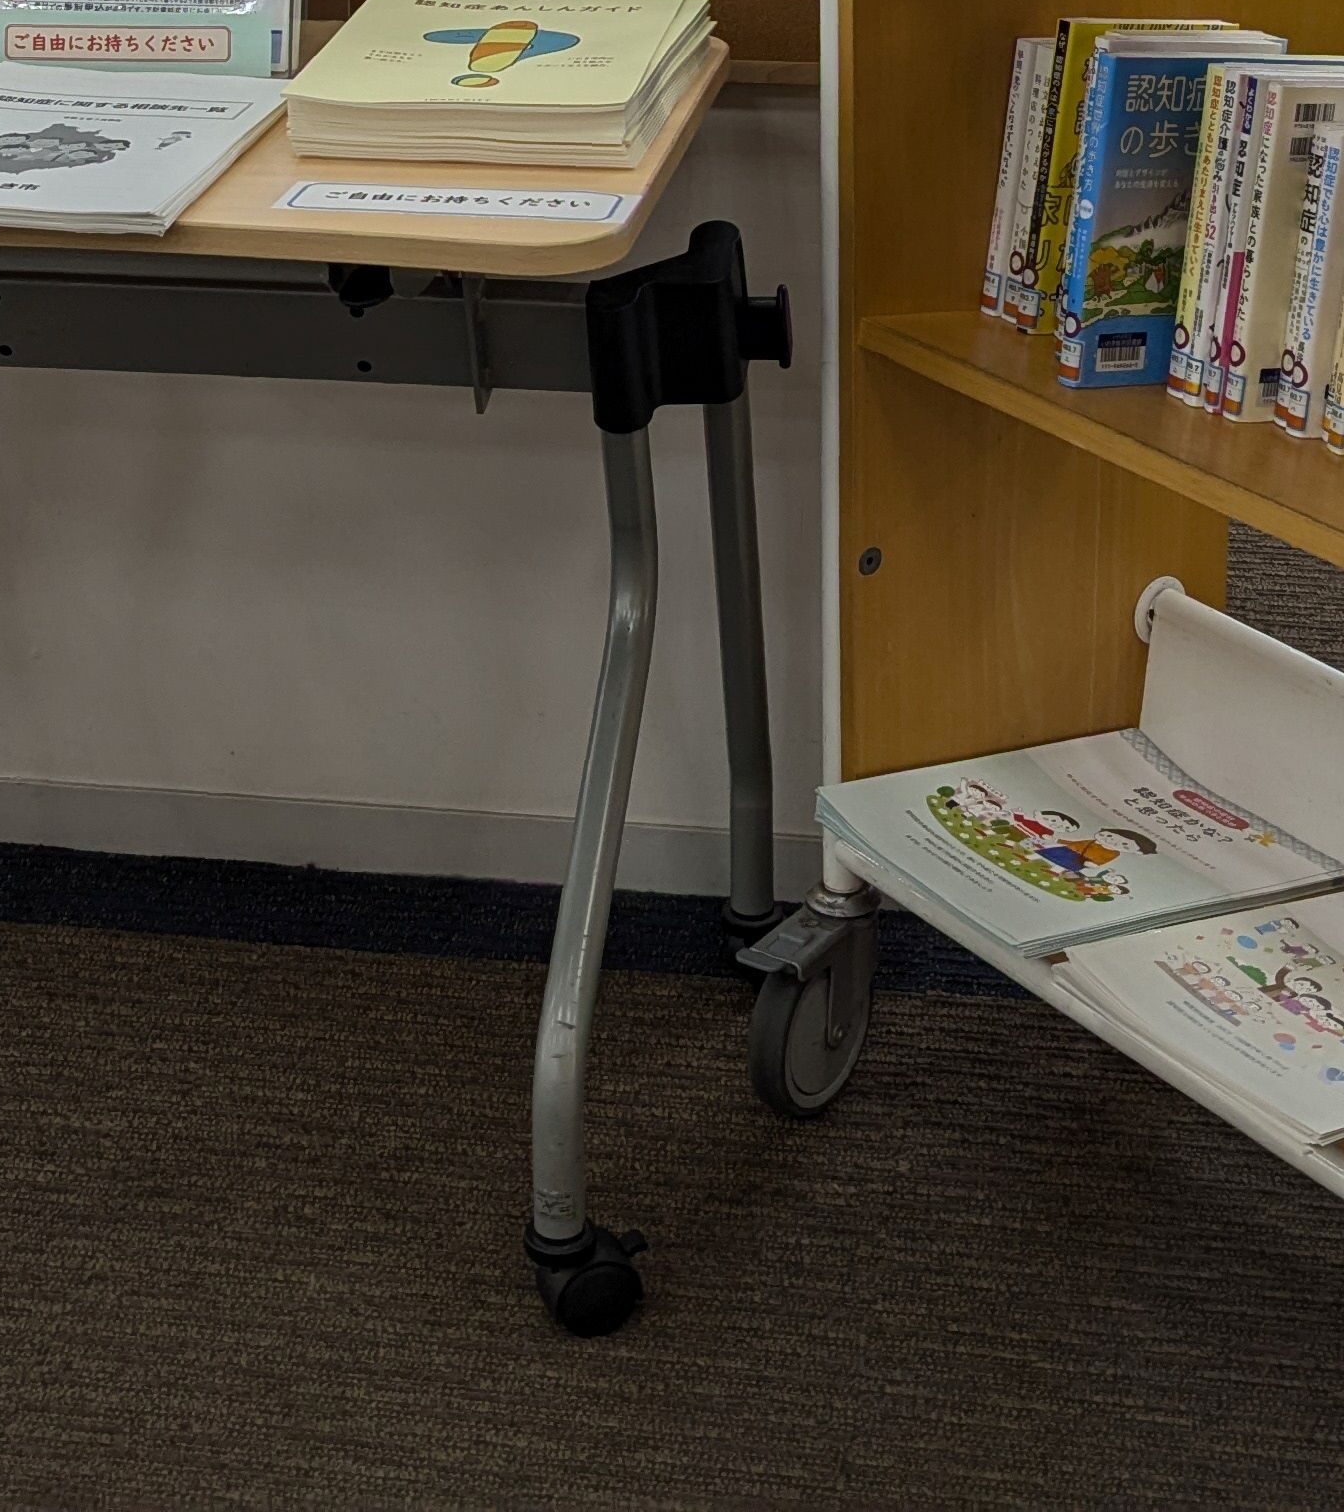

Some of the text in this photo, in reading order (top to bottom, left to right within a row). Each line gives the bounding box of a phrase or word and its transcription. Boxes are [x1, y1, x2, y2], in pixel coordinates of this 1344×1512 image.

[414, 0, 642, 13] 認知症あんしんガイド
[14, 32, 214, 53] ご自由にお持ちください
[325, 191, 590, 209] ご自由にお持ちください
